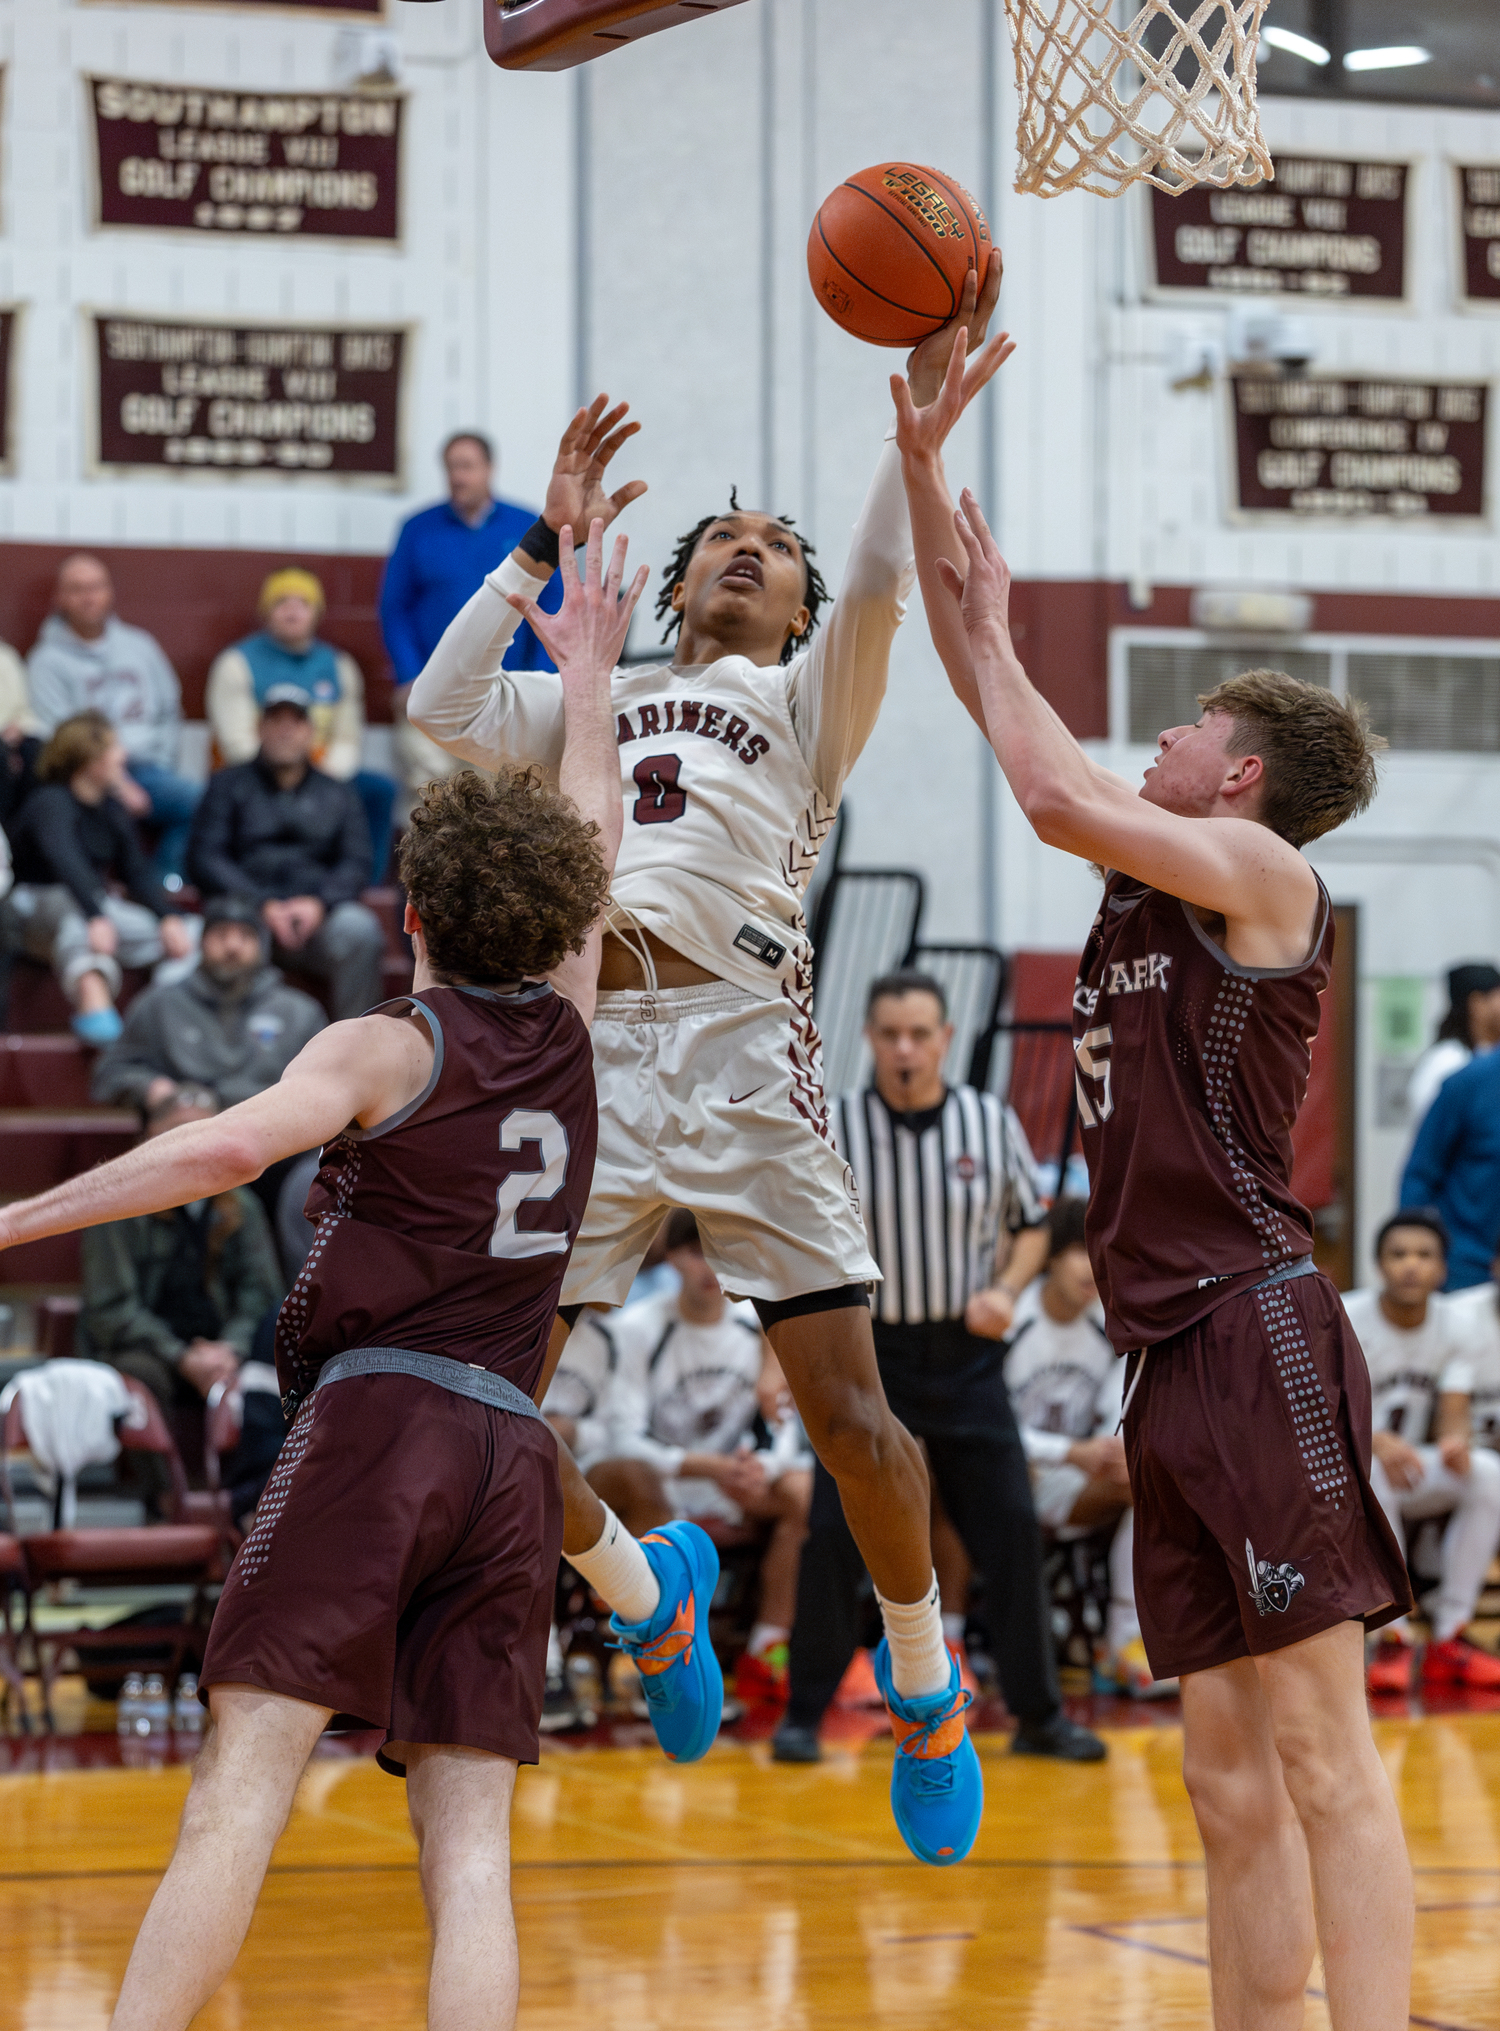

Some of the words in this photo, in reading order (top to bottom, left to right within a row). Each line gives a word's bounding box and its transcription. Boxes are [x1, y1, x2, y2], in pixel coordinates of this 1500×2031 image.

[98, 84, 396, 136] SOUTHAMPTON
[158, 127, 270, 165] LEAGUE
[119, 156, 198, 200] GOLF
[209, 166, 377, 211] CHAMPIONS
[884, 167, 965, 241] LEGACY
[1210, 192, 1295, 227] LEAGUE
[1175, 225, 1240, 264] GOLF
[1247, 228, 1381, 274] CHAMPIONS
[161, 363, 269, 399] LEAGUE
[121, 392, 198, 435] GOLF
[208, 399, 375, 443] CHAMPIONS
[1258, 450, 1325, 489] GOLF
[1331, 452, 1462, 494] CHAMPIONS
[617, 700, 770, 765] ARINERS
[633, 753, 687, 826] 0
[766, 947, 778, 960] M
[1100, 953, 1173, 996] ARK
[640, 995, 656, 1022] S
[489, 1107, 570, 1260] 2
